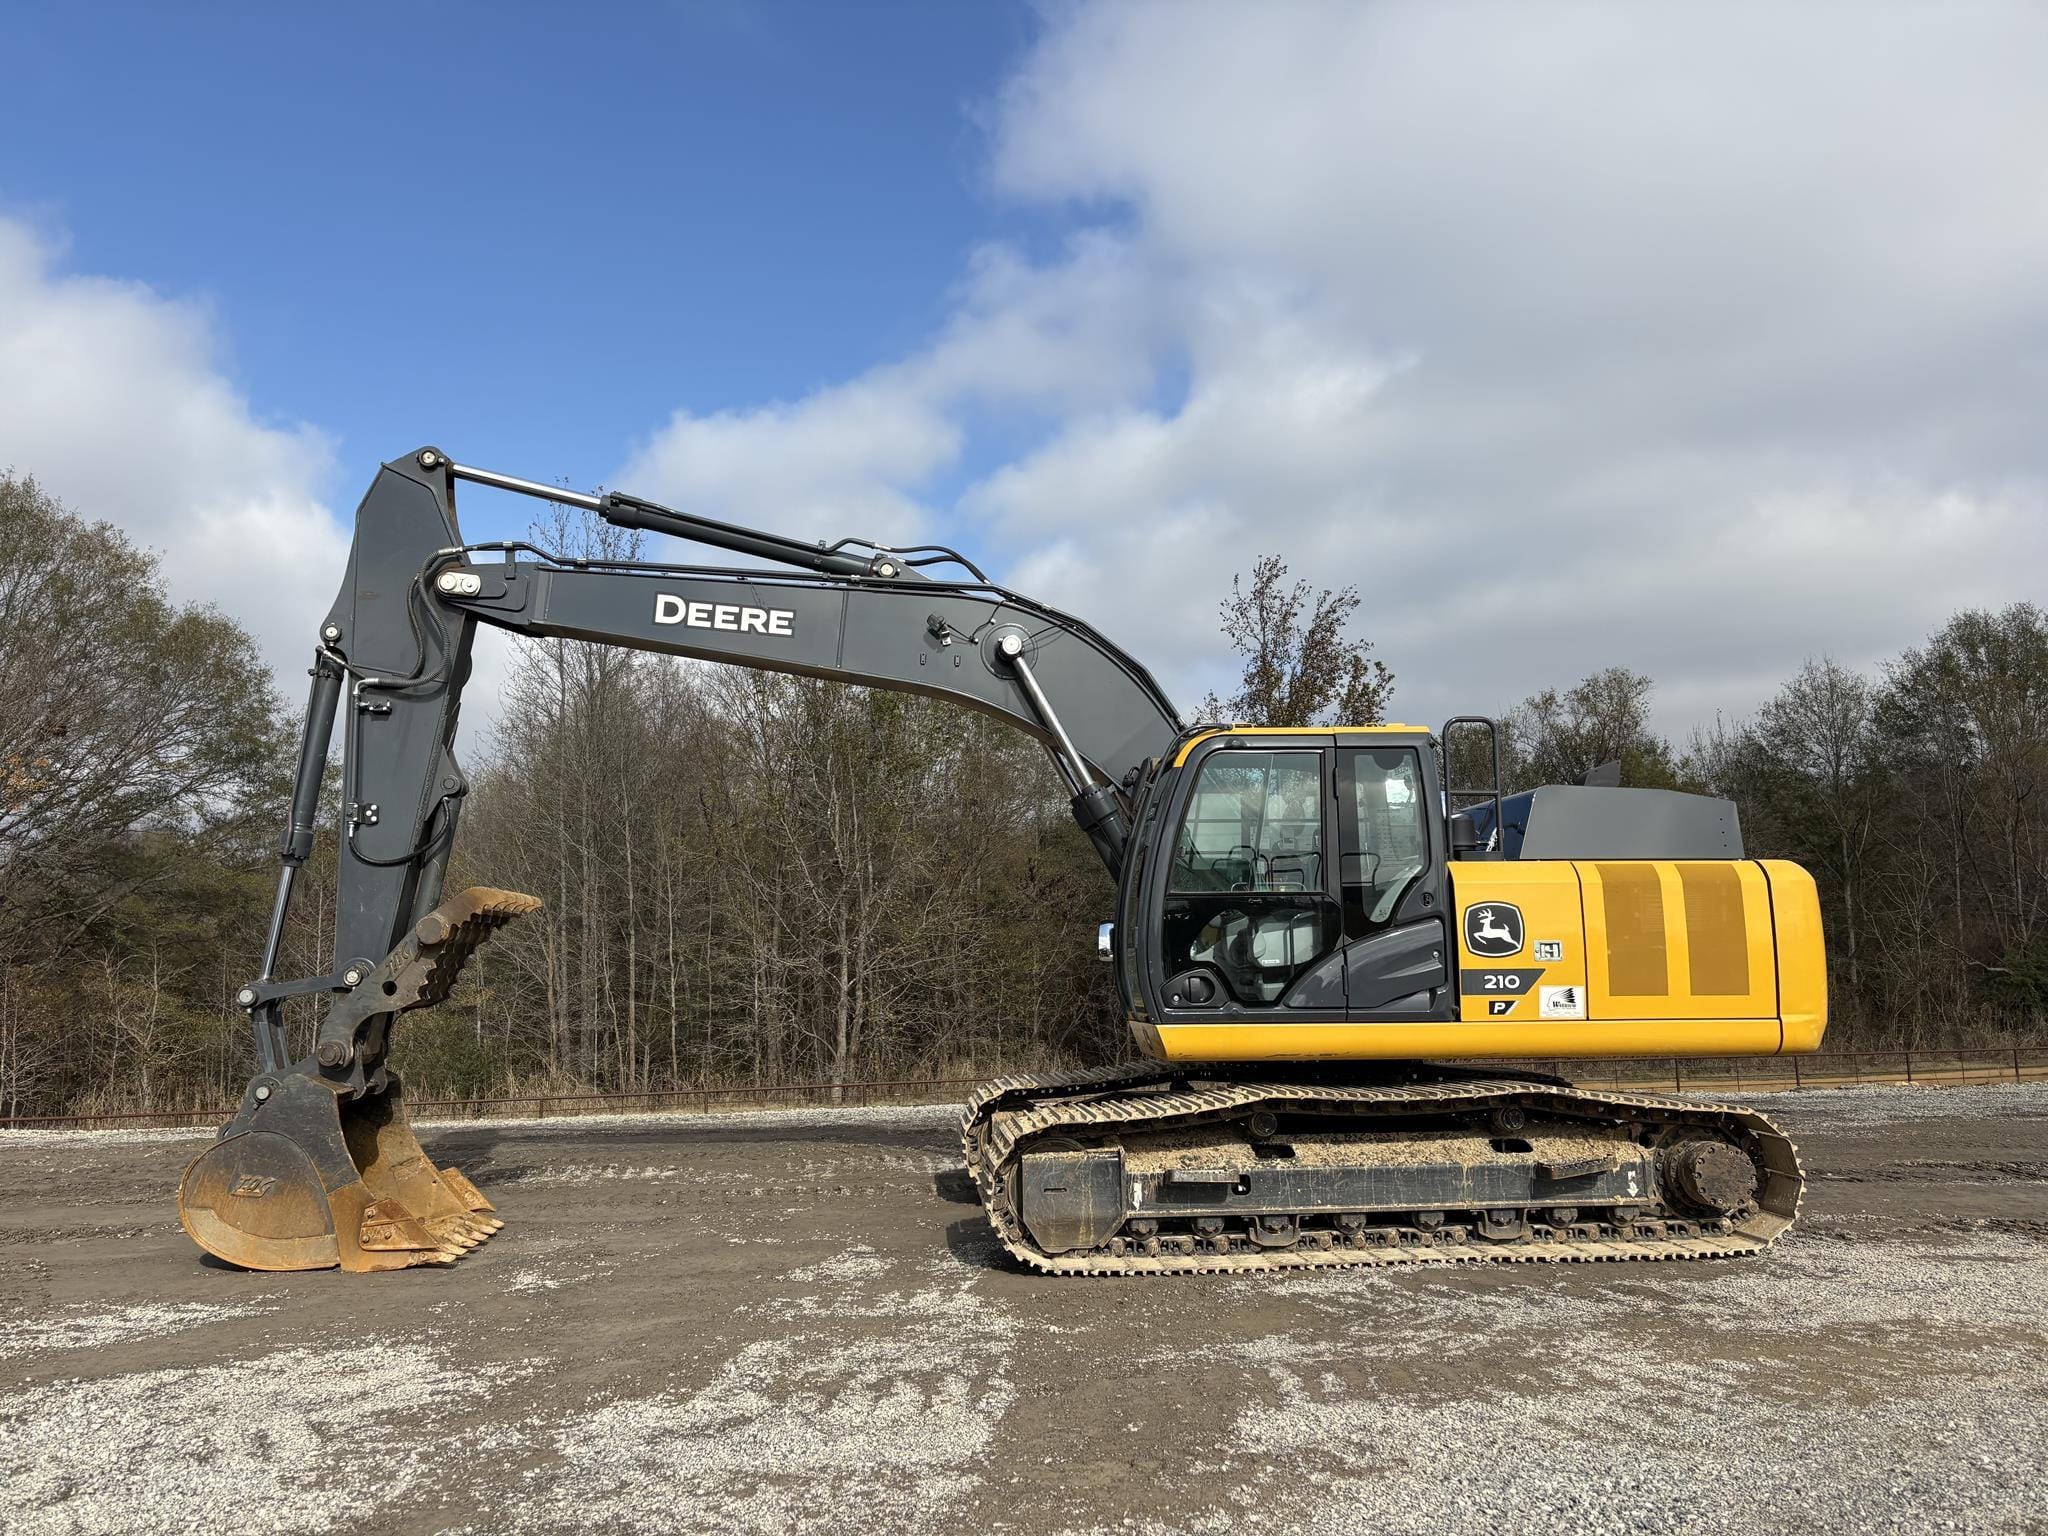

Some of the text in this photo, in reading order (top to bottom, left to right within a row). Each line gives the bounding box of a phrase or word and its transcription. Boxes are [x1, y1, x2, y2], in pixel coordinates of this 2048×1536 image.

[654, 593, 794, 636] DEERE
[1484, 975, 1520, 989] 210
[1493, 1002, 1506, 1014] P
